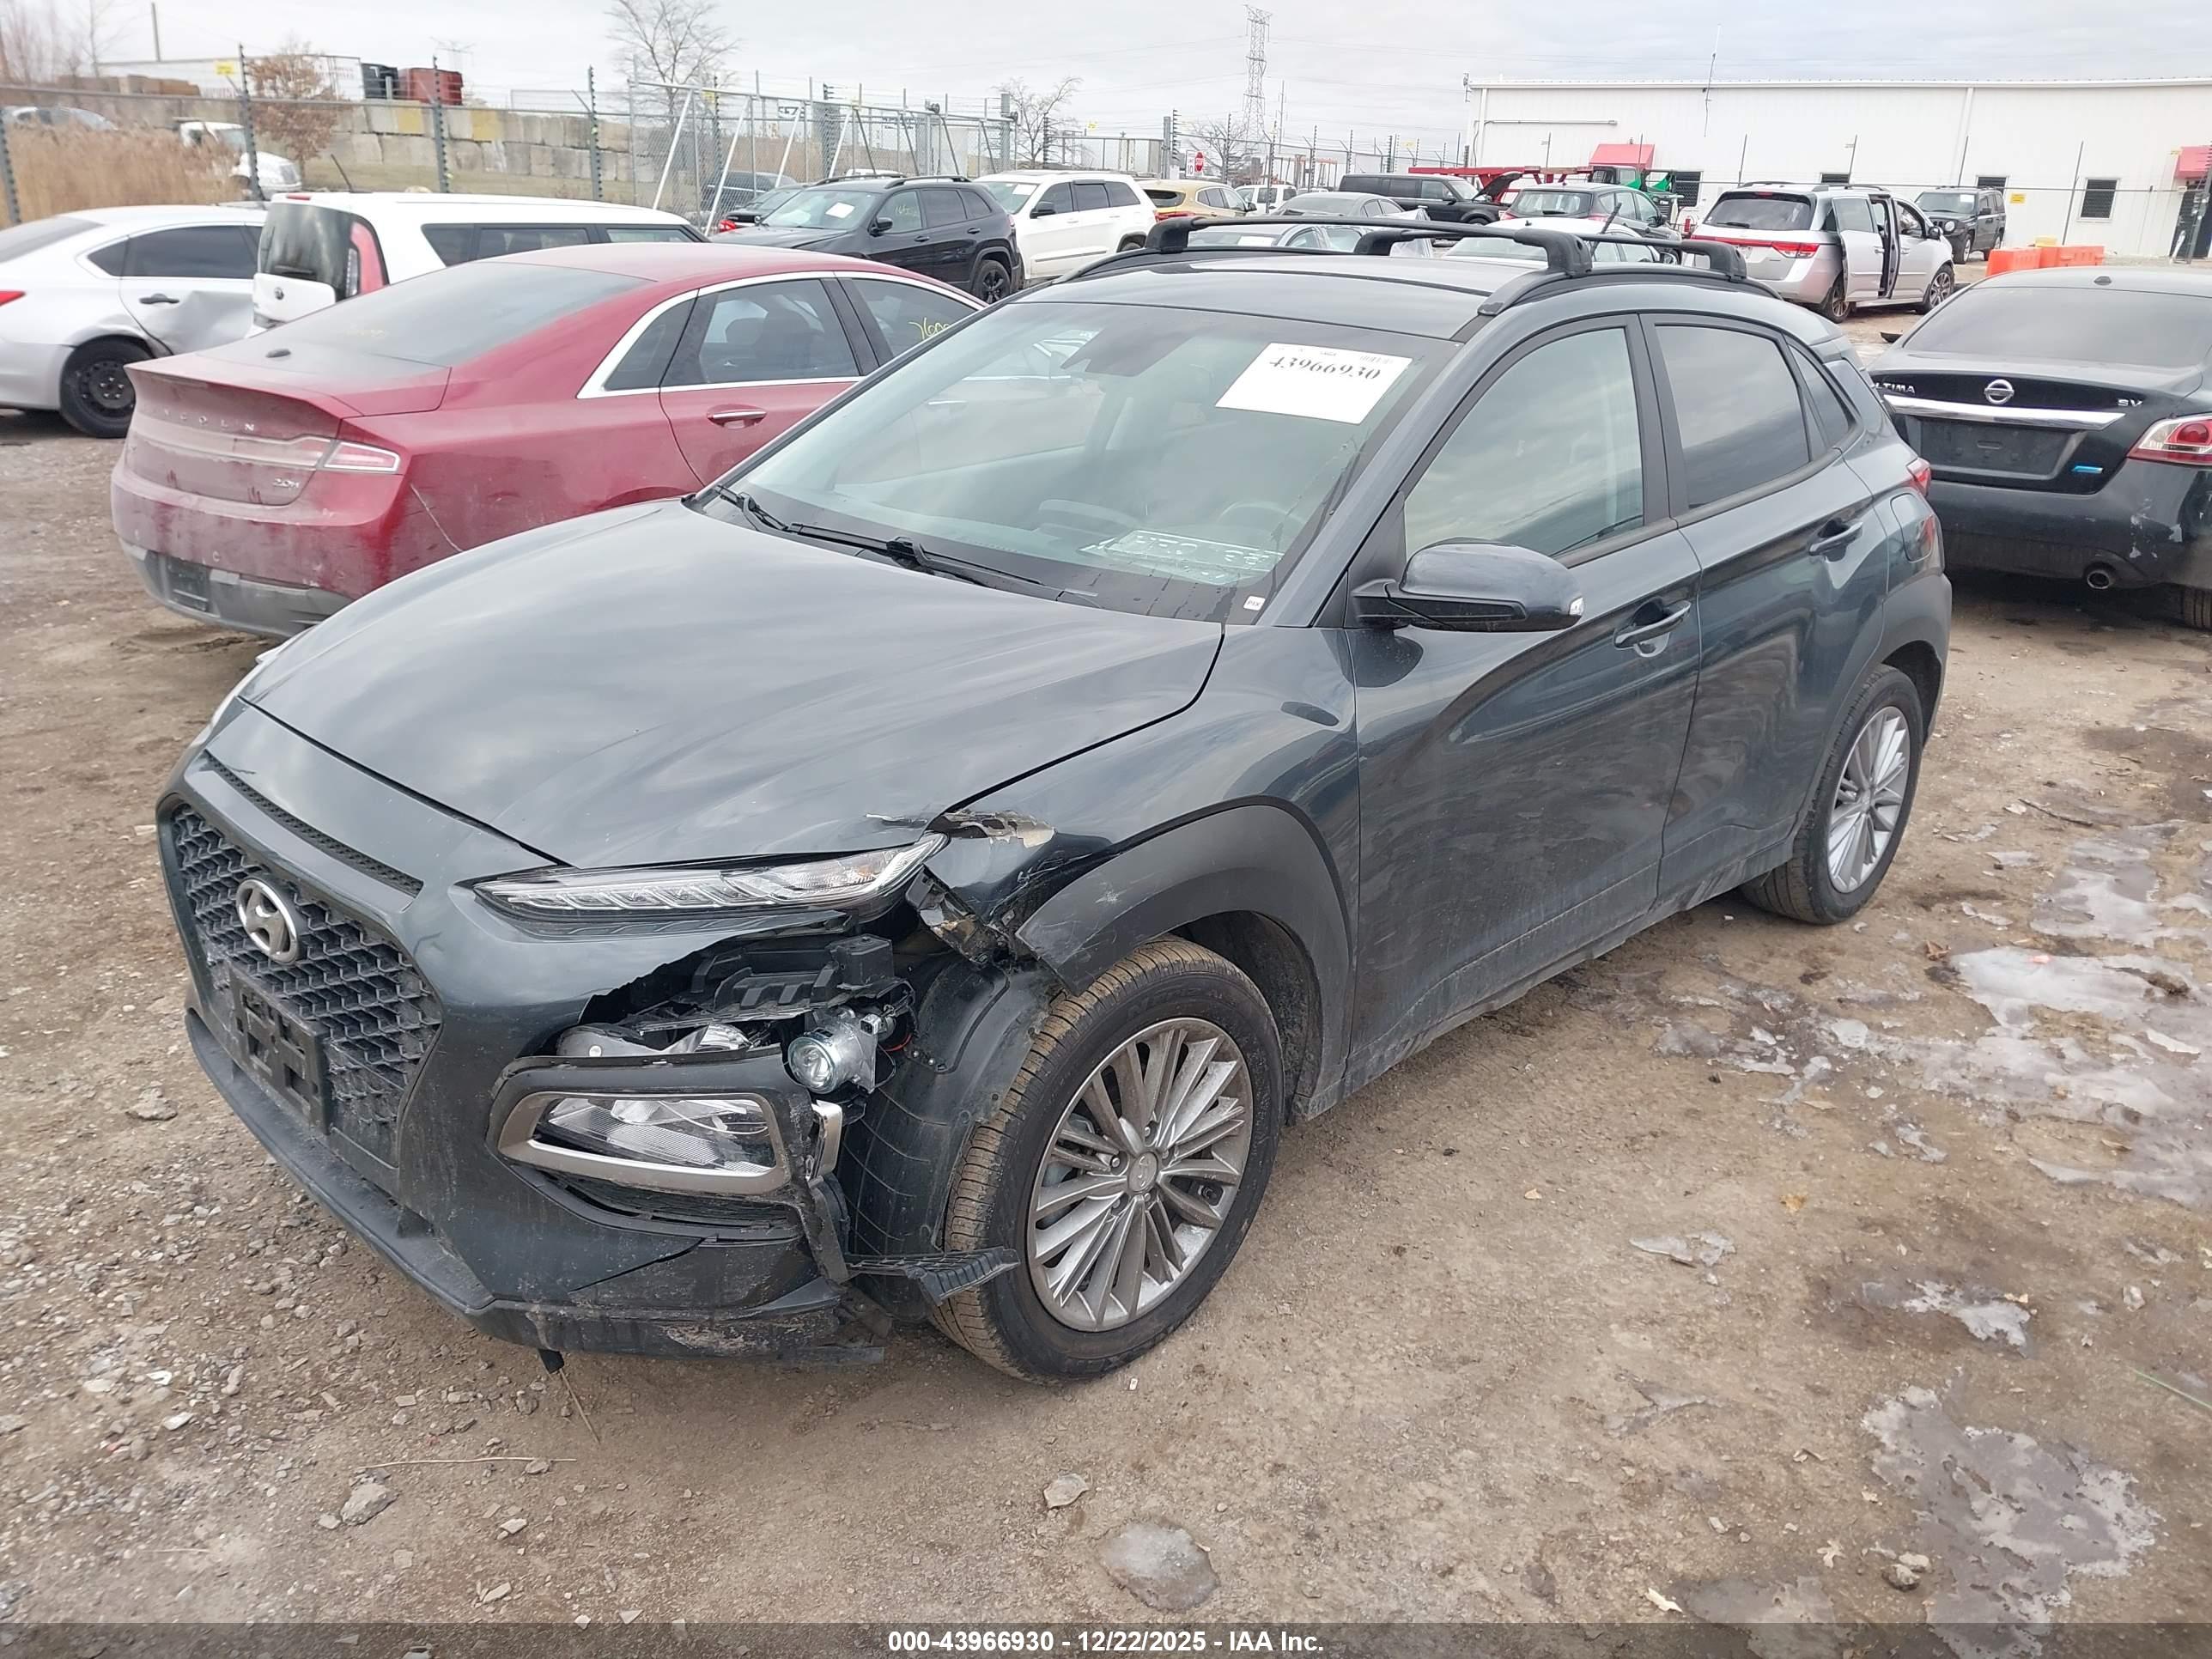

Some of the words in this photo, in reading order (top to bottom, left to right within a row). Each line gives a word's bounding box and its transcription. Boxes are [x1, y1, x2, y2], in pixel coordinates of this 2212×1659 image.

[1269, 356, 1381, 380] 43966930
[1871, 382, 1916, 395] LTIMA
[2118, 398, 2143, 408] SV
